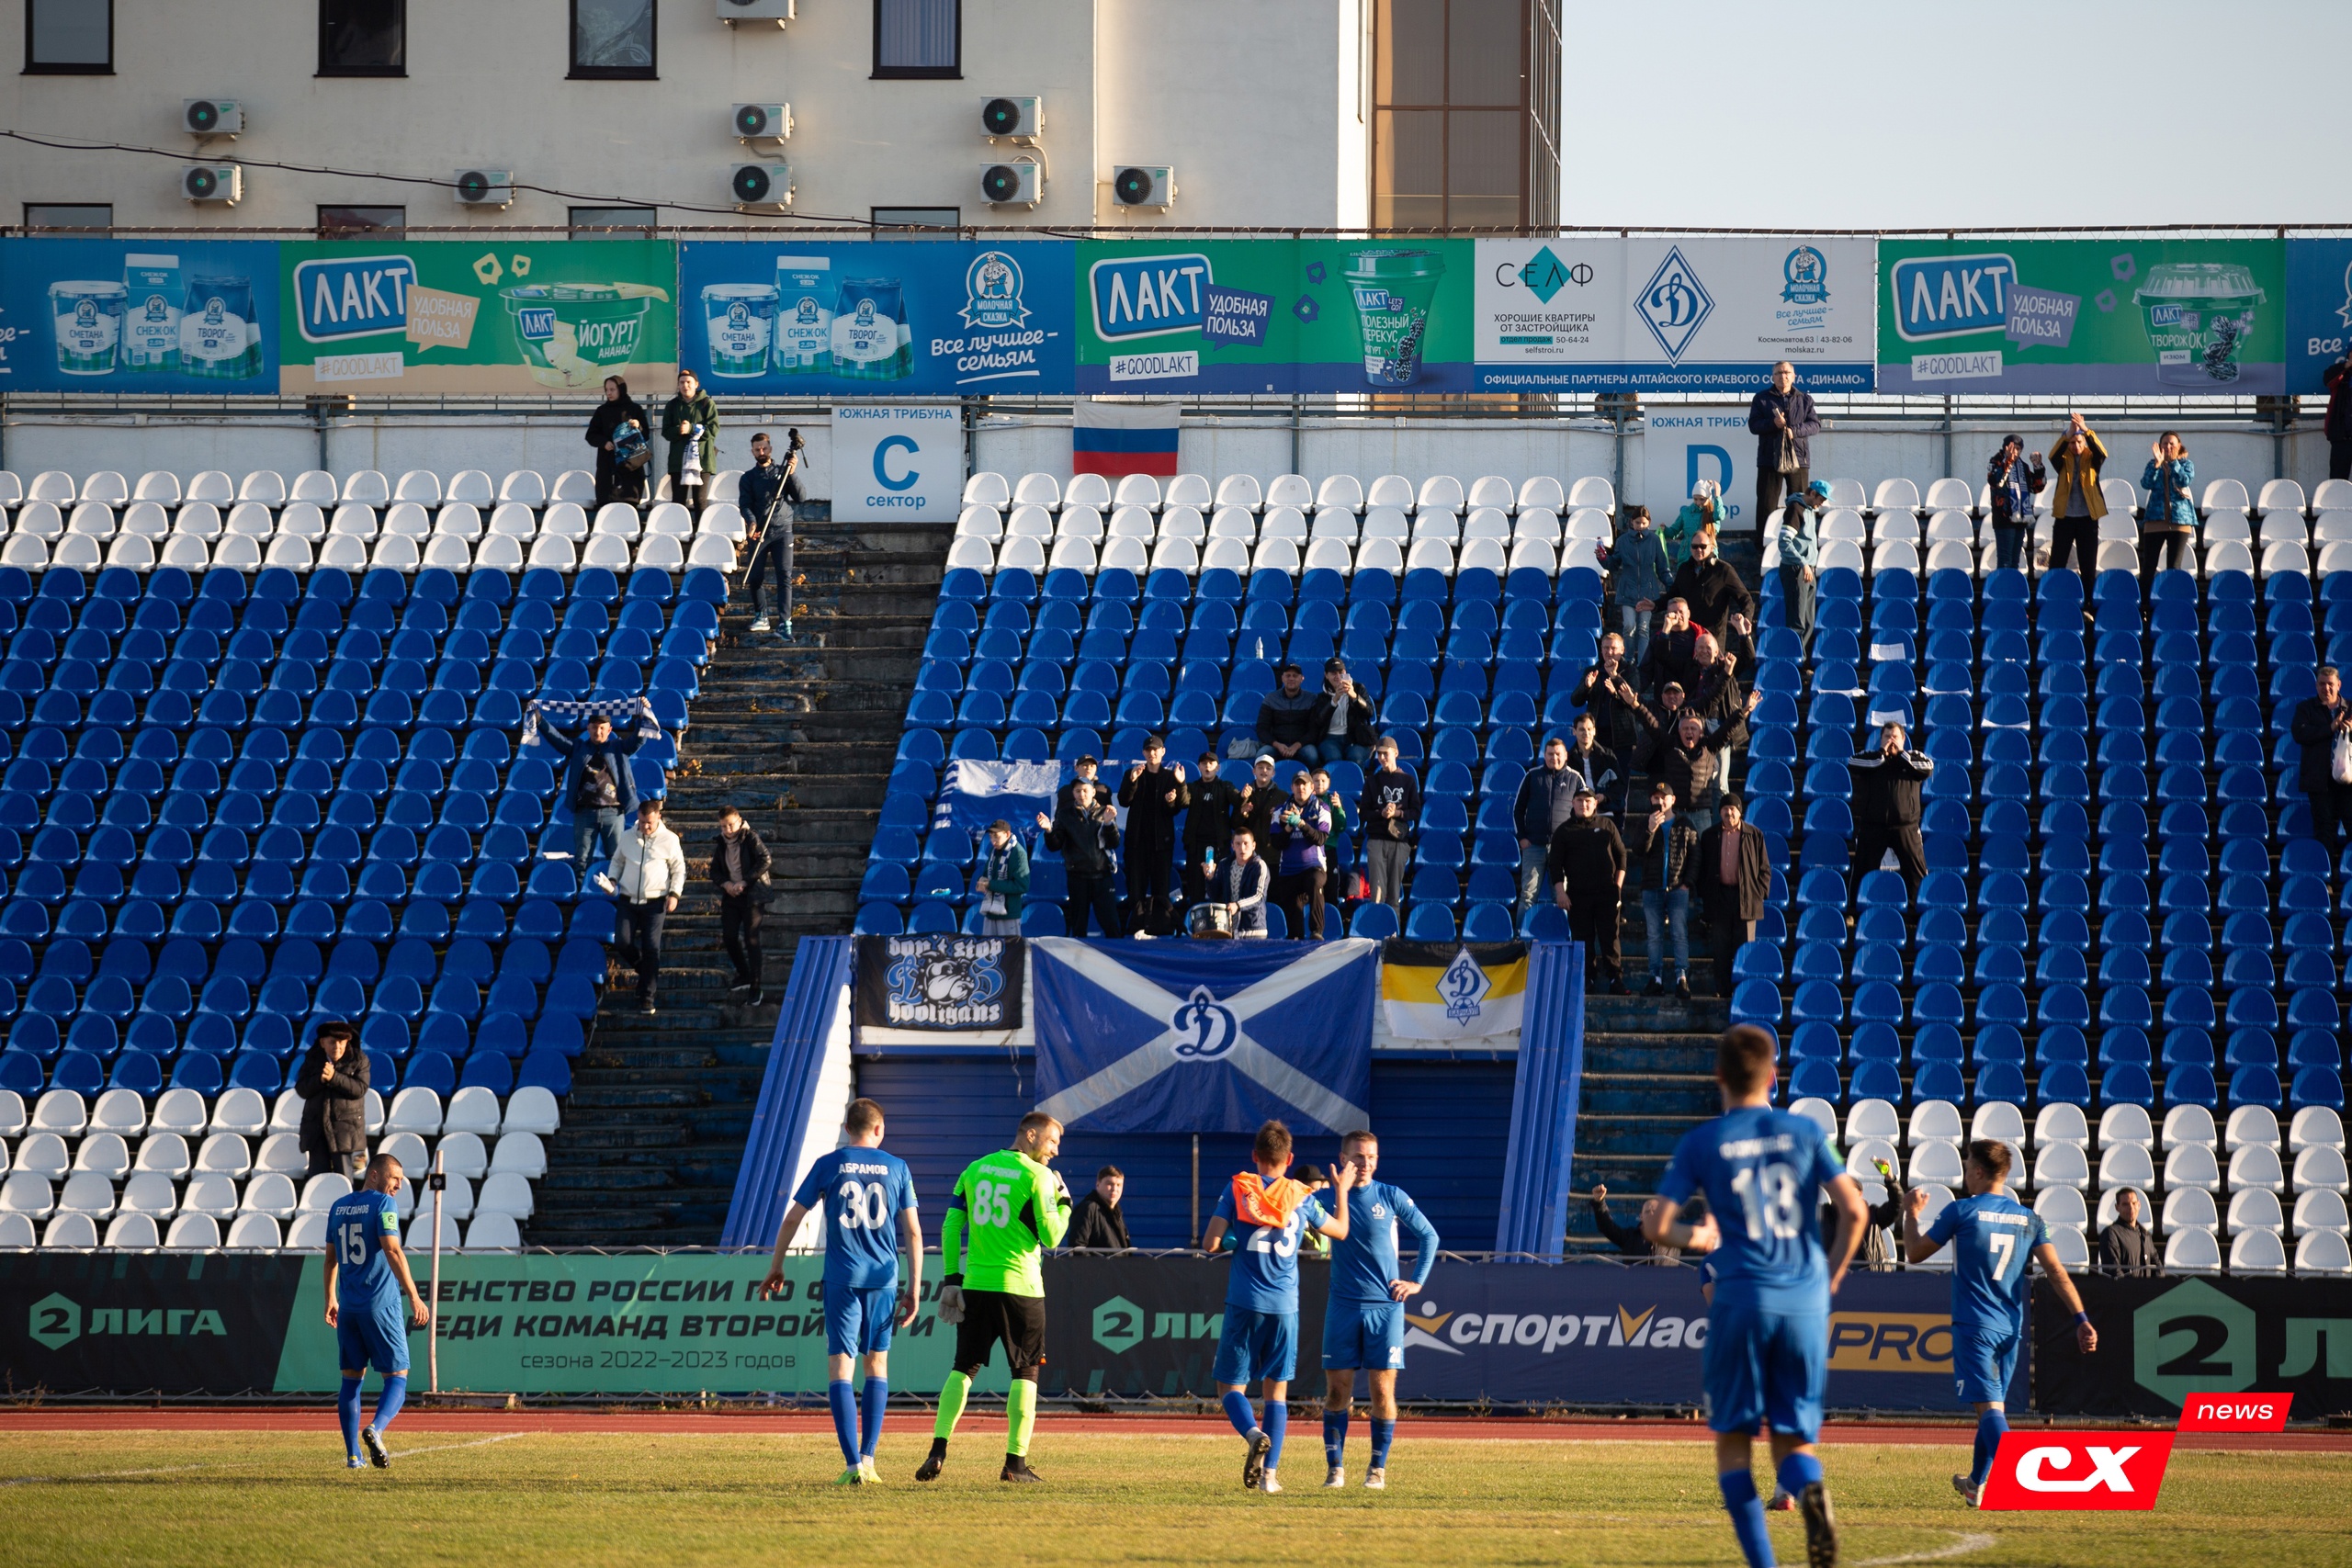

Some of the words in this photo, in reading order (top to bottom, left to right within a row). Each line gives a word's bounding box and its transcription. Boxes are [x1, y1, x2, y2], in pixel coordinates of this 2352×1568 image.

[1496, 263, 1594, 288] СЕЛФ
[313, 267, 409, 325] ЛАКТ
[1108, 265, 1204, 324] ЛАКТ
[1790, 283, 1821, 292] МОЛОЧНАЯ
[1794, 293, 1815, 302] СКАЗКА
[1910, 265, 2008, 324] ЛАКТ
[413, 295, 472, 318] УДОБНАЯ
[977, 299, 1012, 310] МОЛОЧНАЯ
[1209, 293, 1268, 317] УДОБНАЯ
[1358, 291, 1387, 307] ЛАКТ
[2013, 293, 2074, 317] УДОБНАЯ
[525, 312, 554, 333] ЛАКТ
[982, 311, 1008, 322] СКАЗКА
[1361, 313, 1409, 329] ПОЛЕЗНЫЙ
[1494, 313, 1543, 322] ХОРОШИЕ
[1544, 313, 1596, 322] КВАРТИРЫ
[1776, 310, 1792, 320] Все
[1792, 307, 1827, 318] лучшее
[1787, 315, 1824, 326] семьям
[2154, 307, 2182, 322] ЛАКТ
[70, 330, 104, 338] СМЕТАНА
[198, 327, 227, 339] ТВОРОГ
[412, 317, 461, 339] ПОЛЬЗА
[579, 319, 638, 347] ЙОГУРТ
[721, 332, 755, 342] СМЕТАНА
[848, 329, 877, 340] ТВОРОГ
[1206, 316, 1256, 338] ПОЛЬЗА
[1363, 328, 1398, 343] ПЕРЕКУС
[1499, 323, 1513, 333] ОТ
[1515, 322, 1589, 333] ЗАСТРОЙЩИКА
[2010, 316, 2062, 339] ПОЛЬЗА
[598, 344, 632, 358] АНАНАС
[931, 338, 965, 356] Все
[967, 330, 1045, 352] лучшее
[1525, 345, 1565, 354] selfstroi.ru
[1784, 345, 1825, 354] molskaz.ru
[2308, 337, 2343, 355] Все
[320, 356, 398, 376] #GOODLAKT
[956, 349, 1036, 372] семьям
[1114, 355, 1193, 376] #GOODLAKT
[1917, 355, 1996, 375] #GOODLAKT
[1484, 374, 1569, 386] ОФИЦИАЛЬНЫЕ
[1571, 374, 1628, 385] ПАРТНЕРЫ
[1630, 372, 1702, 385] АЛТАЙСКОГО
[1704, 374, 1760, 384] КРАЕВОГО
[1806, 374, 1866, 385] «ДИНАМО»
[839, 408, 890, 419] ЮЖНАЯ
[893, 408, 954, 419] ТРИБУНА
[1652, 417, 1703, 427] ЮЖНАЯ
[1706, 417, 1749, 427] ТРИБУ
[1687, 445, 1734, 500] D
[866, 496, 926, 511] сектор
[953, 938, 1003, 960] stop
[888, 1001, 1003, 1026] hooligans
[839, 1162, 888, 1176] АБРАМОВ
[838, 1180, 888, 1230] 30
[973, 1179, 1012, 1229] 85
[1731, 1163, 1803, 1241] 18
[338, 1223, 367, 1265] 15
[1989, 1232, 2016, 1281] 7
[587, 1280, 729, 1302] РОССИИ
[39, 1307, 71, 1335] 2
[88, 1308, 228, 1336] ЛИГА
[513, 1314, 669, 1340] КОМАНД
[680, 1308, 826, 1337] ВТОРОЙ
[1102, 1311, 1135, 1338] 2
[2156, 1314, 2233, 1377] 2
[521, 1355, 594, 1369] сезона
[735, 1354, 796, 1371] годов
[1956, 1379, 1965, 1396] 7
